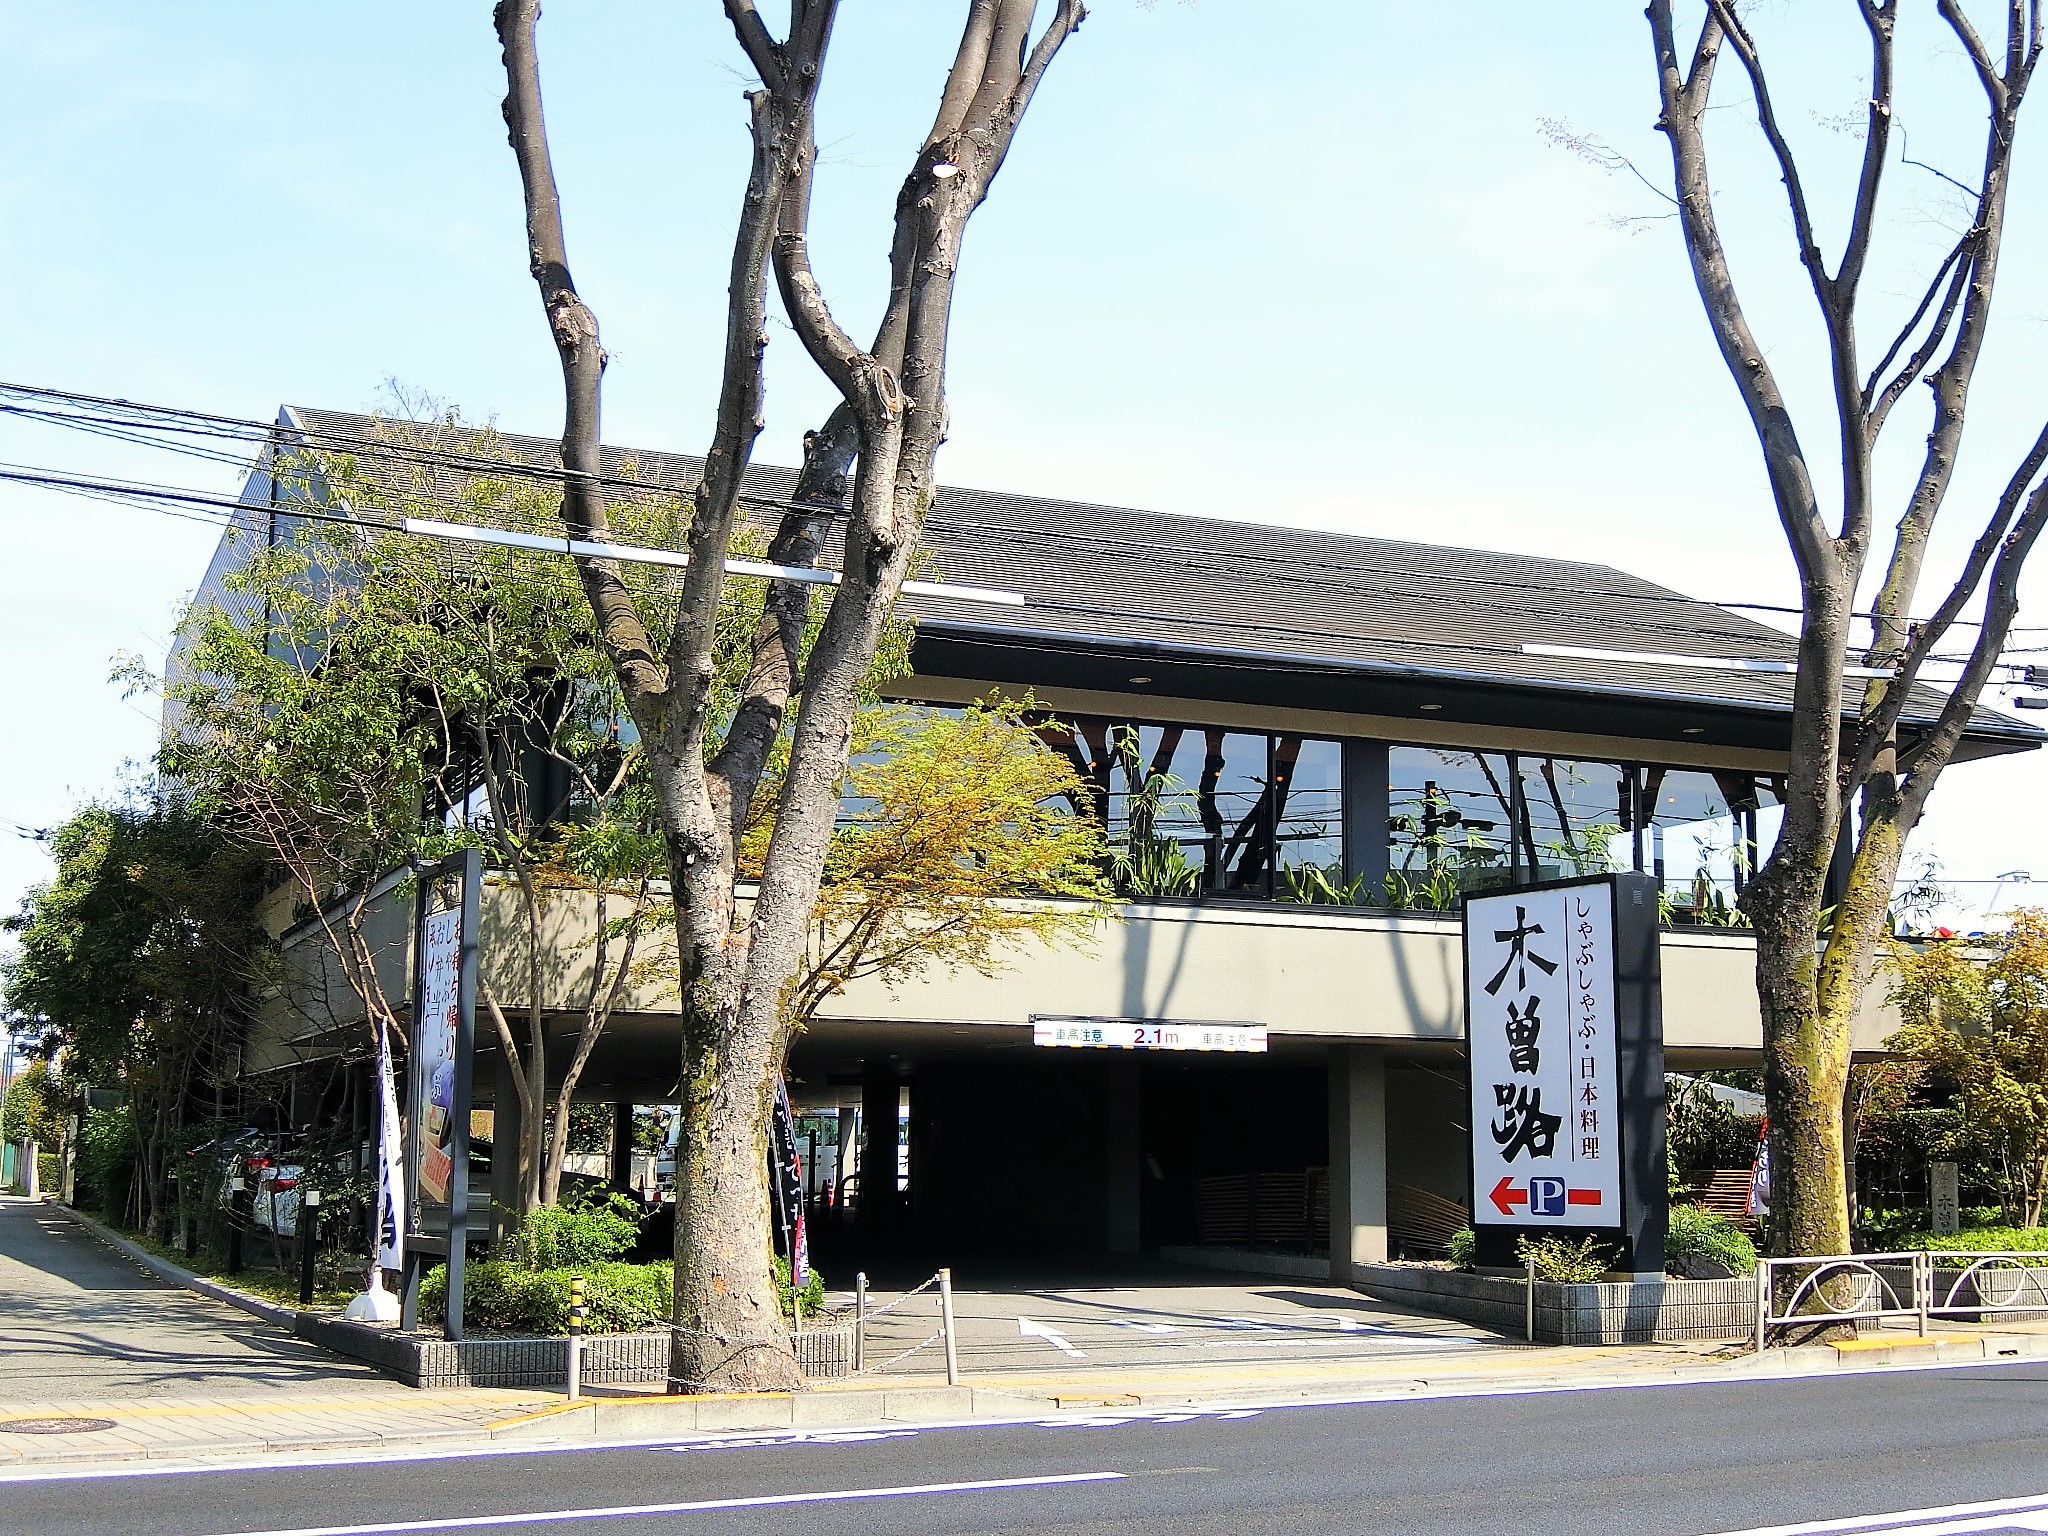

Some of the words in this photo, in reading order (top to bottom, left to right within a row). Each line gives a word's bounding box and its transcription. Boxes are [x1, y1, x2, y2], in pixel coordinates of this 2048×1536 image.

[1133, 1028, 1179, 1044] 2.1m
[1483, 905, 1564, 1164] 木曽路
[1575, 896, 1600, 1161] しゃぶしゃぶ・日本料理
[1532, 1180, 1563, 1213] P
